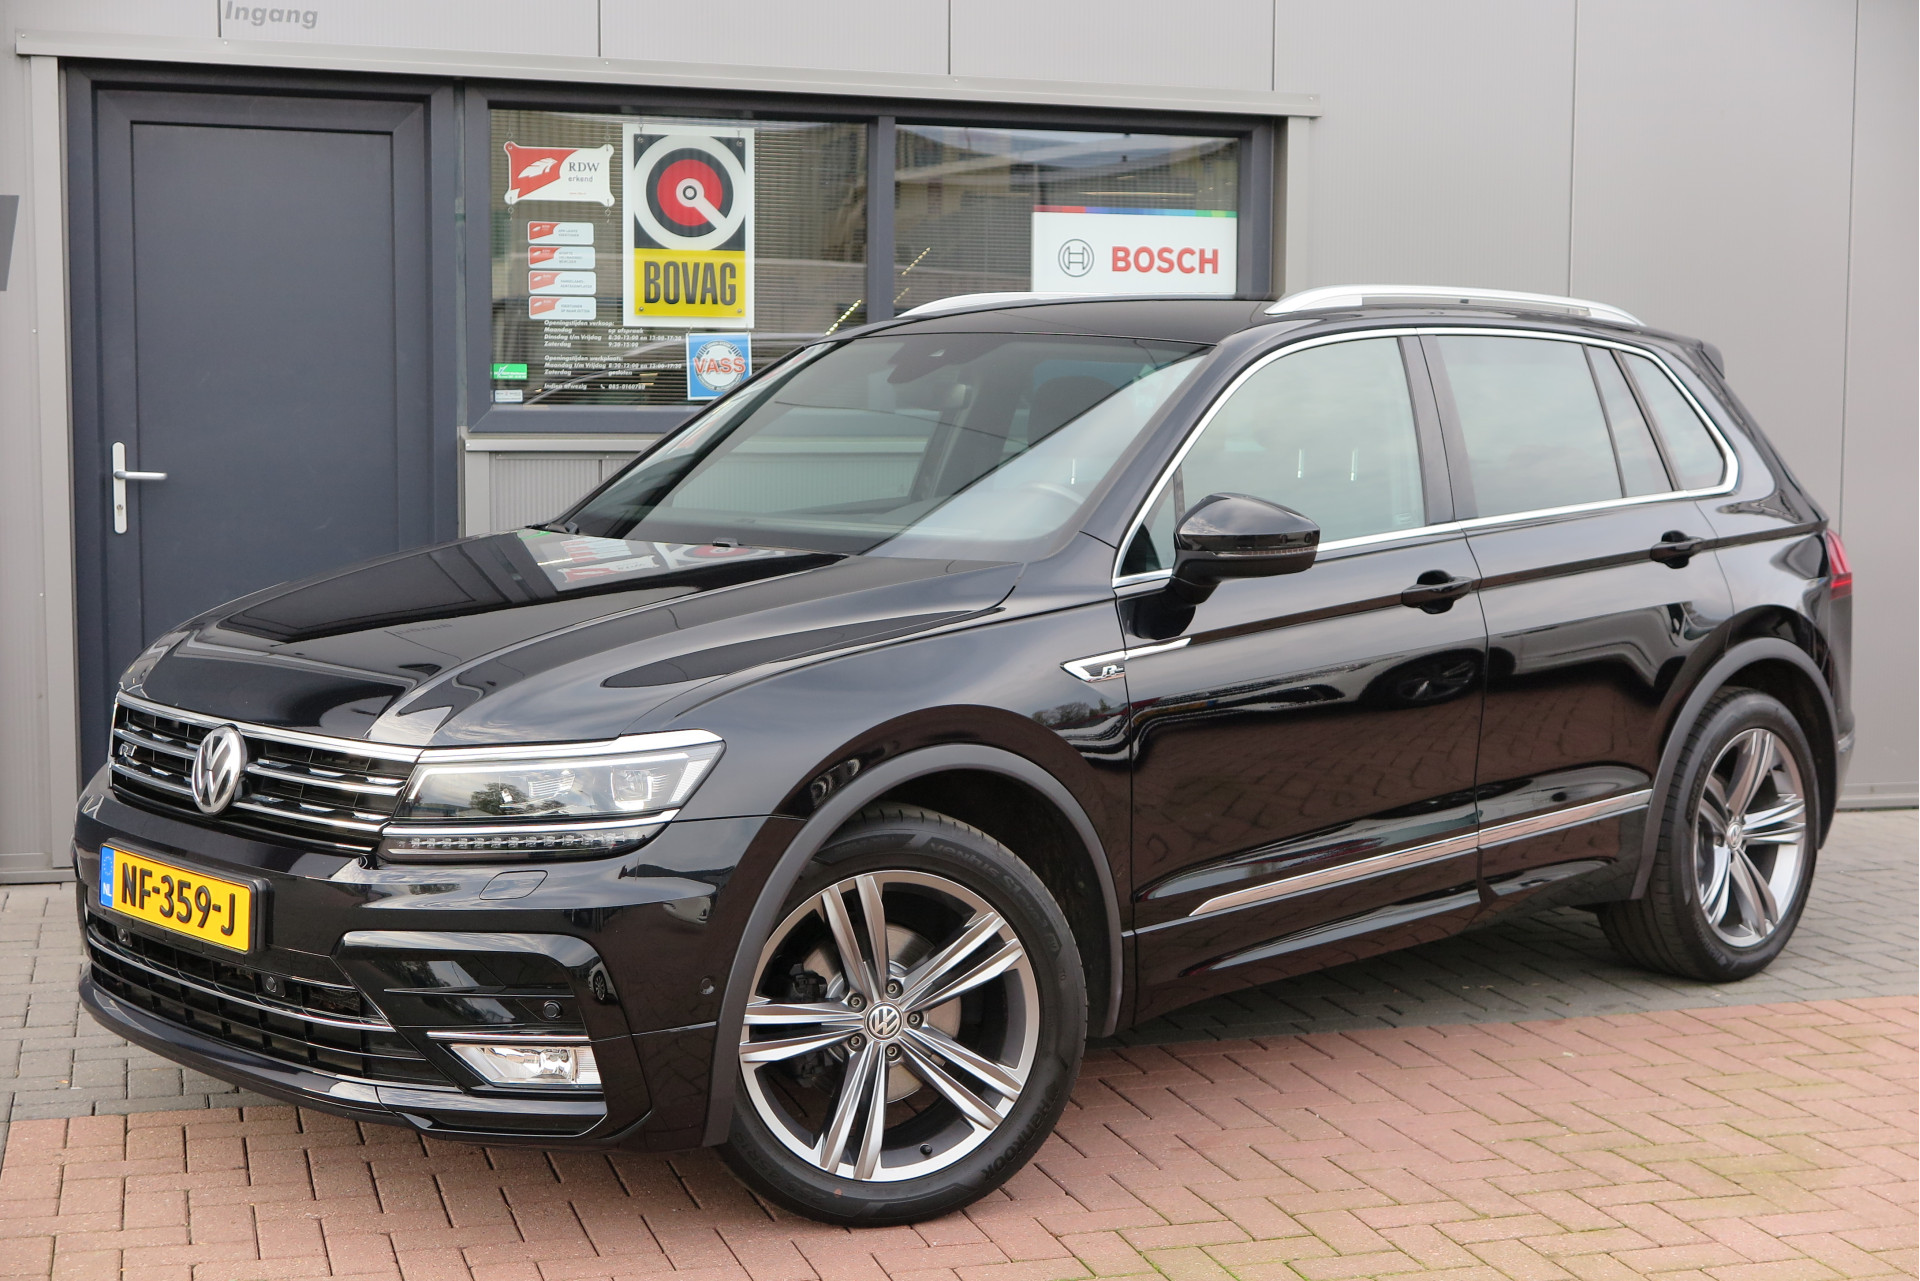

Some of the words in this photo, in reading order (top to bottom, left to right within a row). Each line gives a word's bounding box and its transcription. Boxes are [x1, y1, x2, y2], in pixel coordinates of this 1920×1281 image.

[225, 0, 318, 29] Ingang
[568, 162, 599, 172] RDW
[1112, 246, 1218, 274] BOSCH
[644, 261, 736, 305] BOVAG
[693, 357, 746, 374] VASS
[103, 882, 112, 896] NL
[122, 862, 236, 936] NF-359-J
